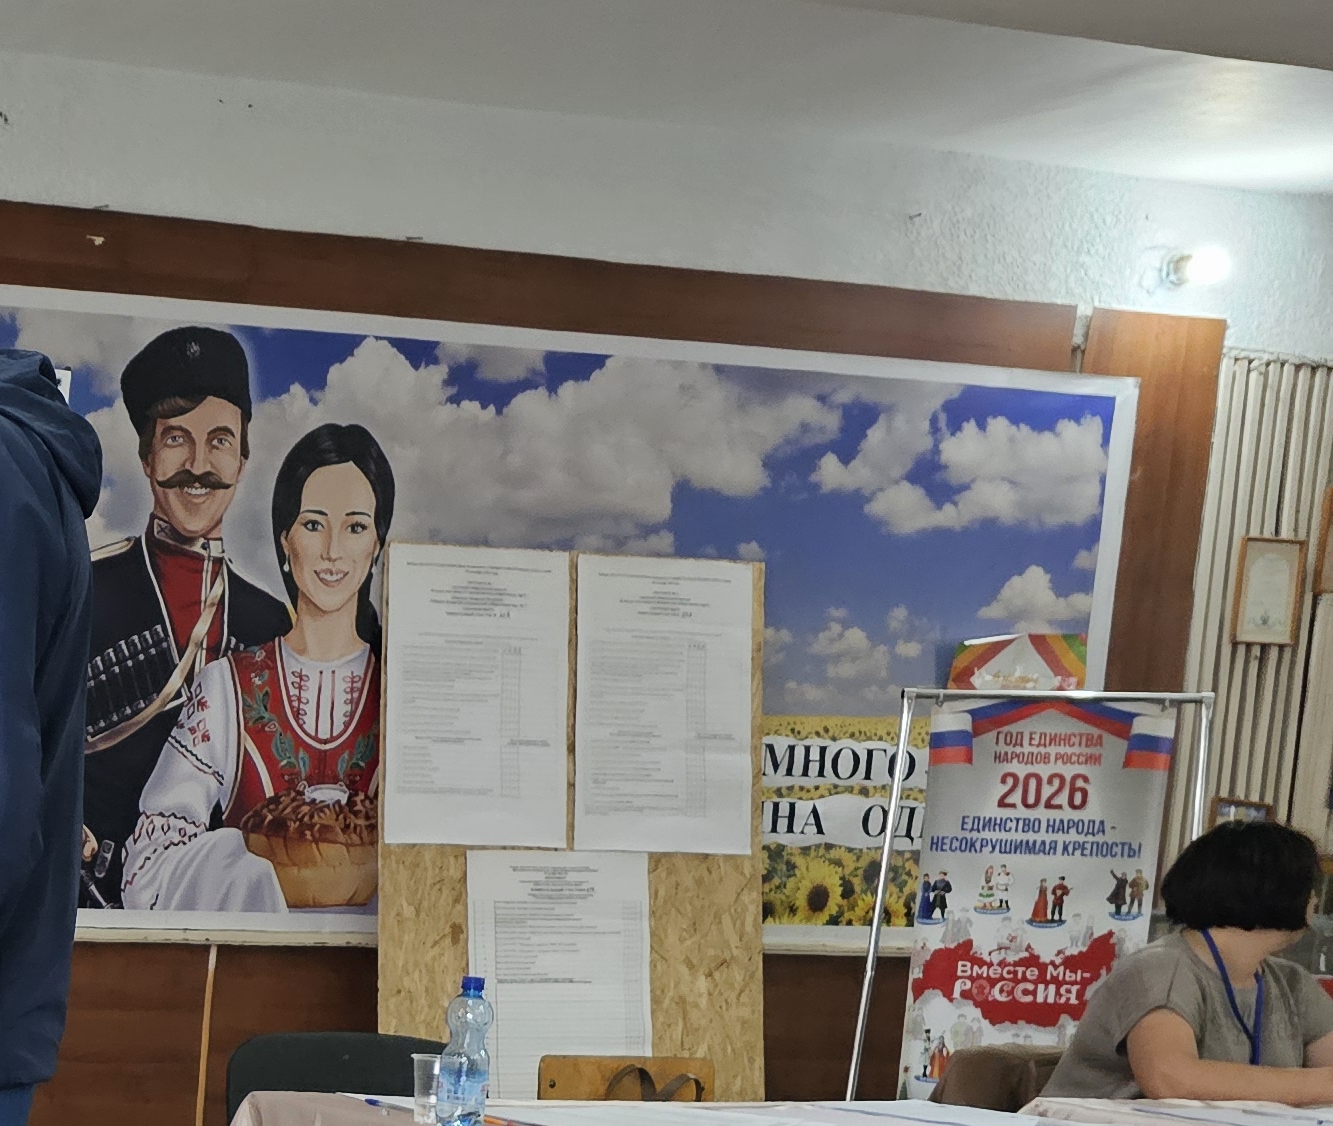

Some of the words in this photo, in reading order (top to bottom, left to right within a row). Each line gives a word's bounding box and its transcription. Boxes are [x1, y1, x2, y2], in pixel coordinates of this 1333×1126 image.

[995, 730, 1024, 749] ГОД
[1029, 732, 1103, 749] ЕДИНСТВА
[762, 743, 916, 782] МНОГО
[994, 751, 1050, 766] НАРОДОВ
[1054, 752, 1102, 767] РОССИИ
[997, 771, 1091, 811] 2026
[762, 801, 825, 835] НА
[862, 804, 924, 846] ОД
[961, 815, 1041, 834] ЕДИНСТВО
[1046, 818, 1106, 837] НАРОДА
[930, 836, 1057, 856] НЕСОКРУШИМАЯ
[957, 961, 1038, 979] Вместе
